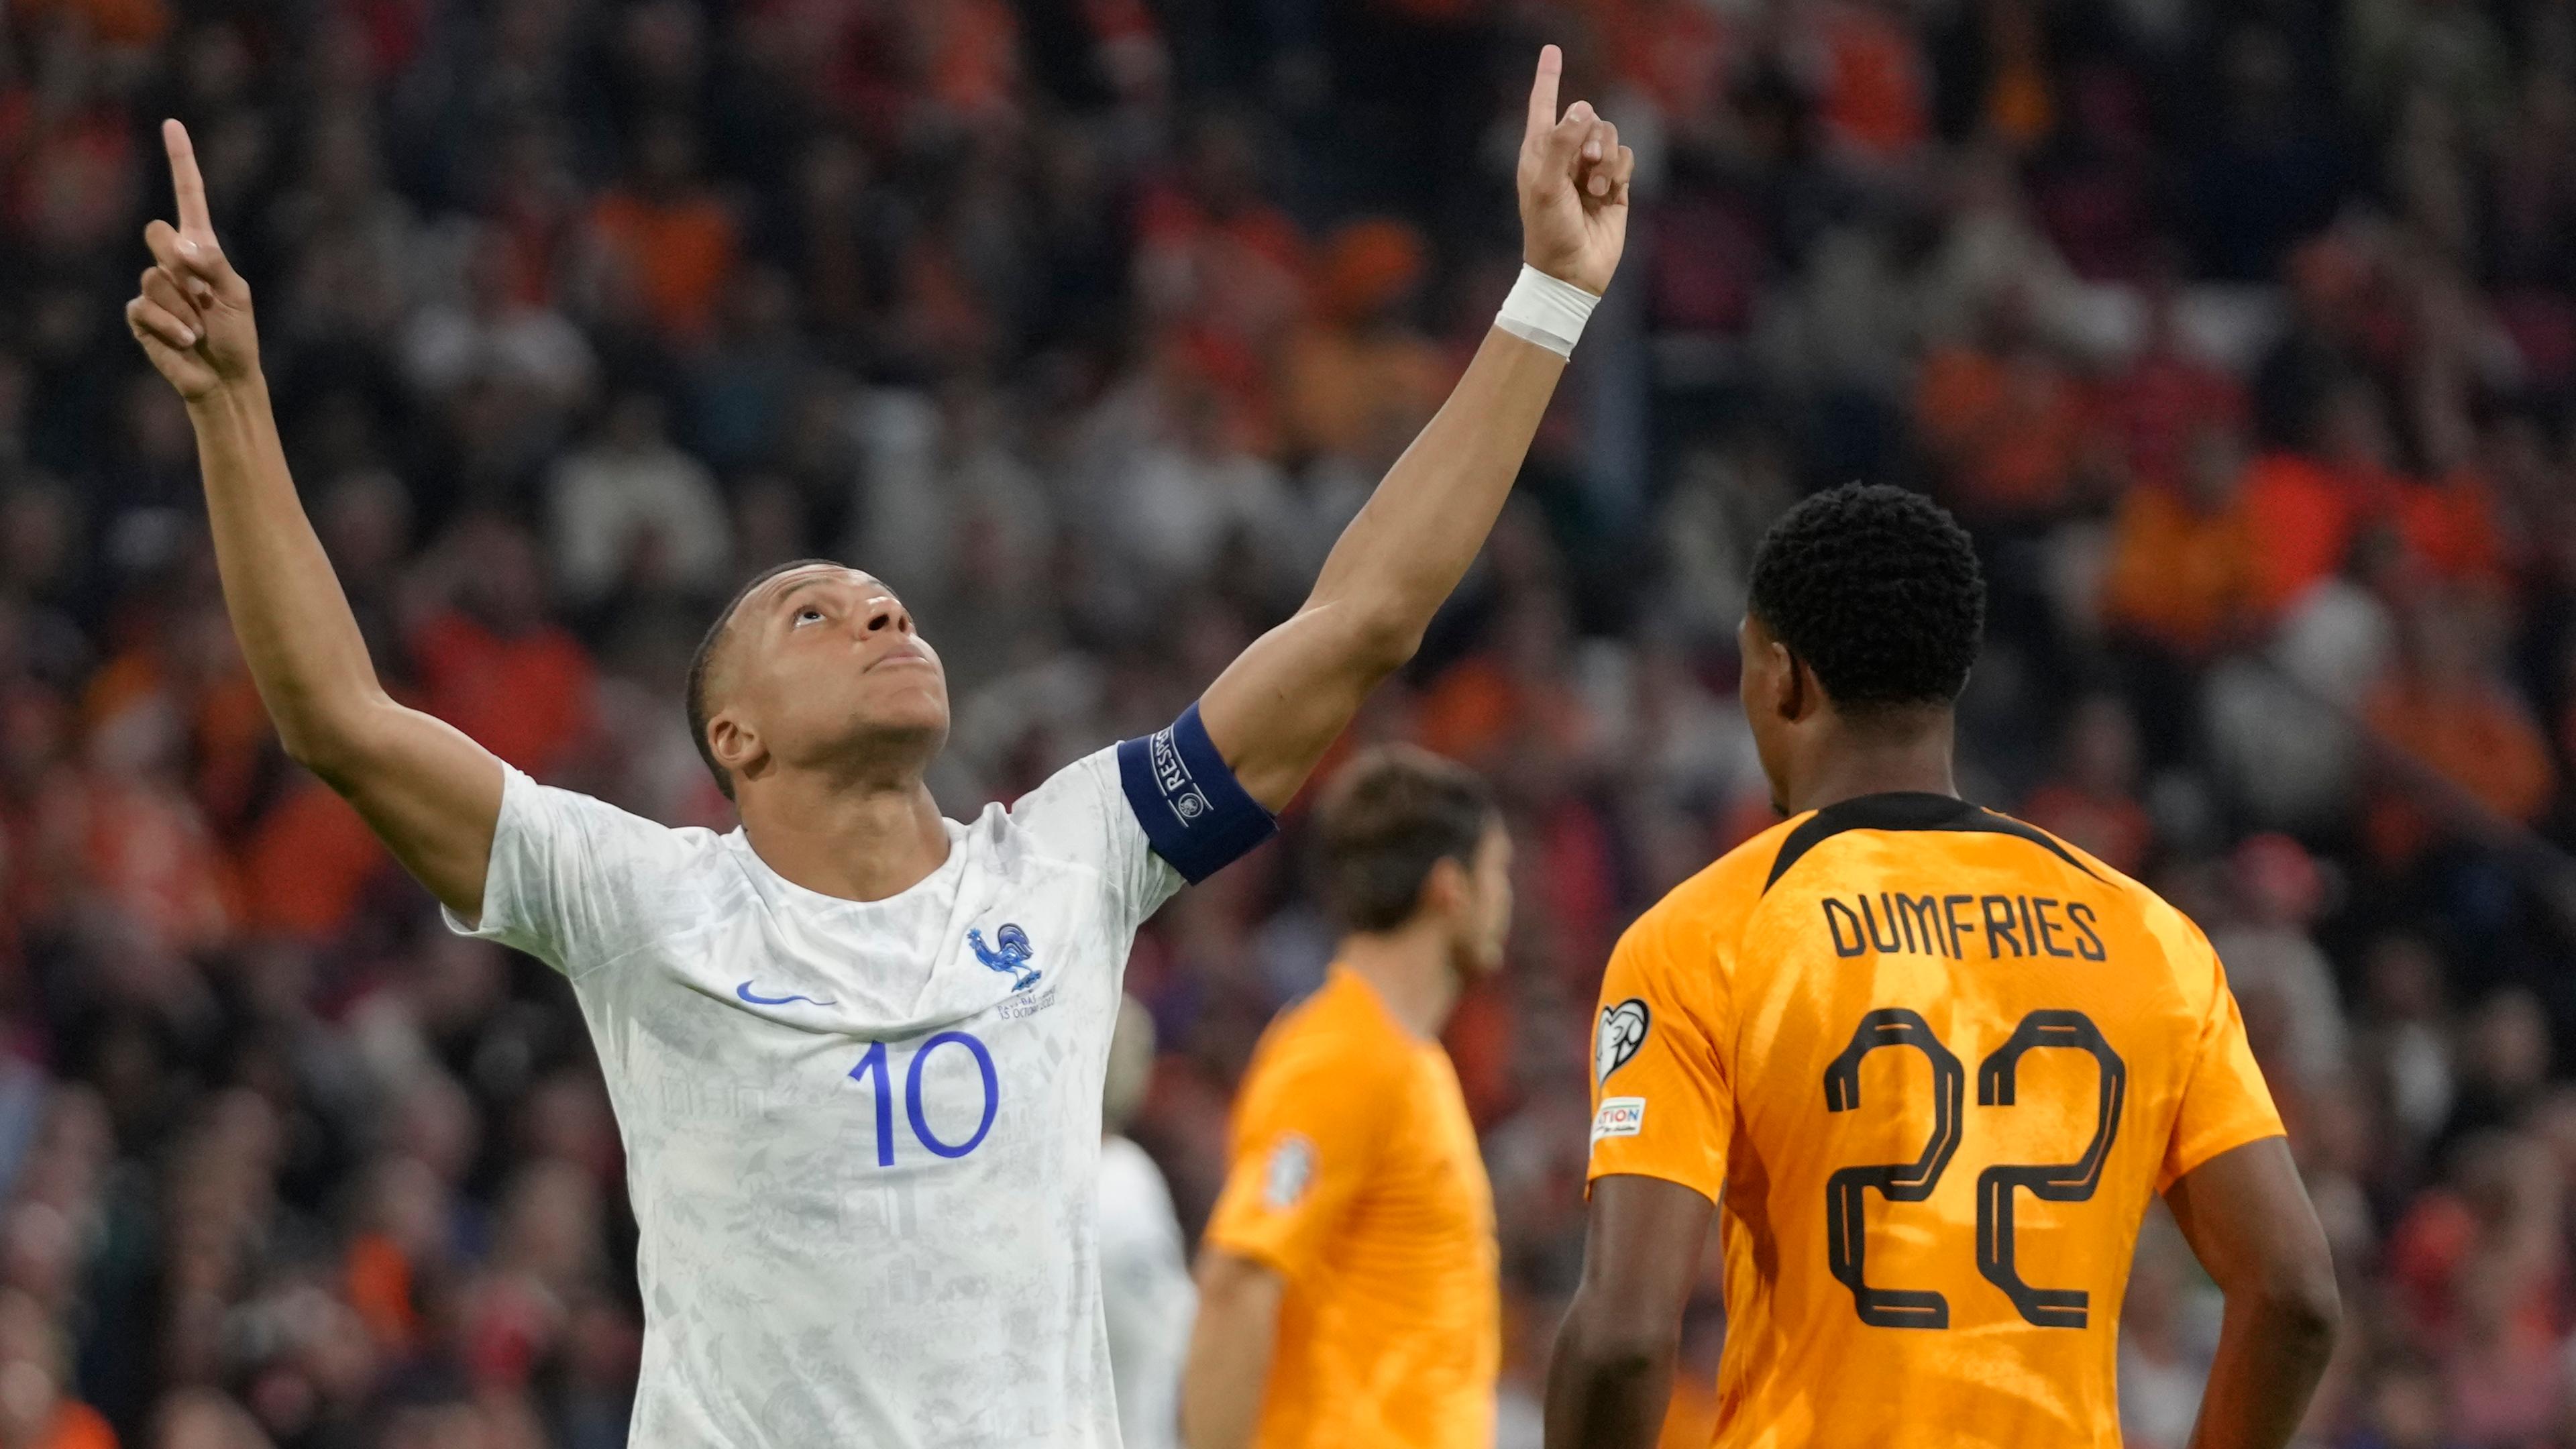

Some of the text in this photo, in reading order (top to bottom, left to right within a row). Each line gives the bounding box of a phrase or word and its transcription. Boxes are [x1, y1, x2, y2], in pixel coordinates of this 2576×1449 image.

[1821, 892, 2106, 962] DUMFRIES
[847, 1030, 1000, 1167] 10
[1823, 1008, 2127, 1330] 22
